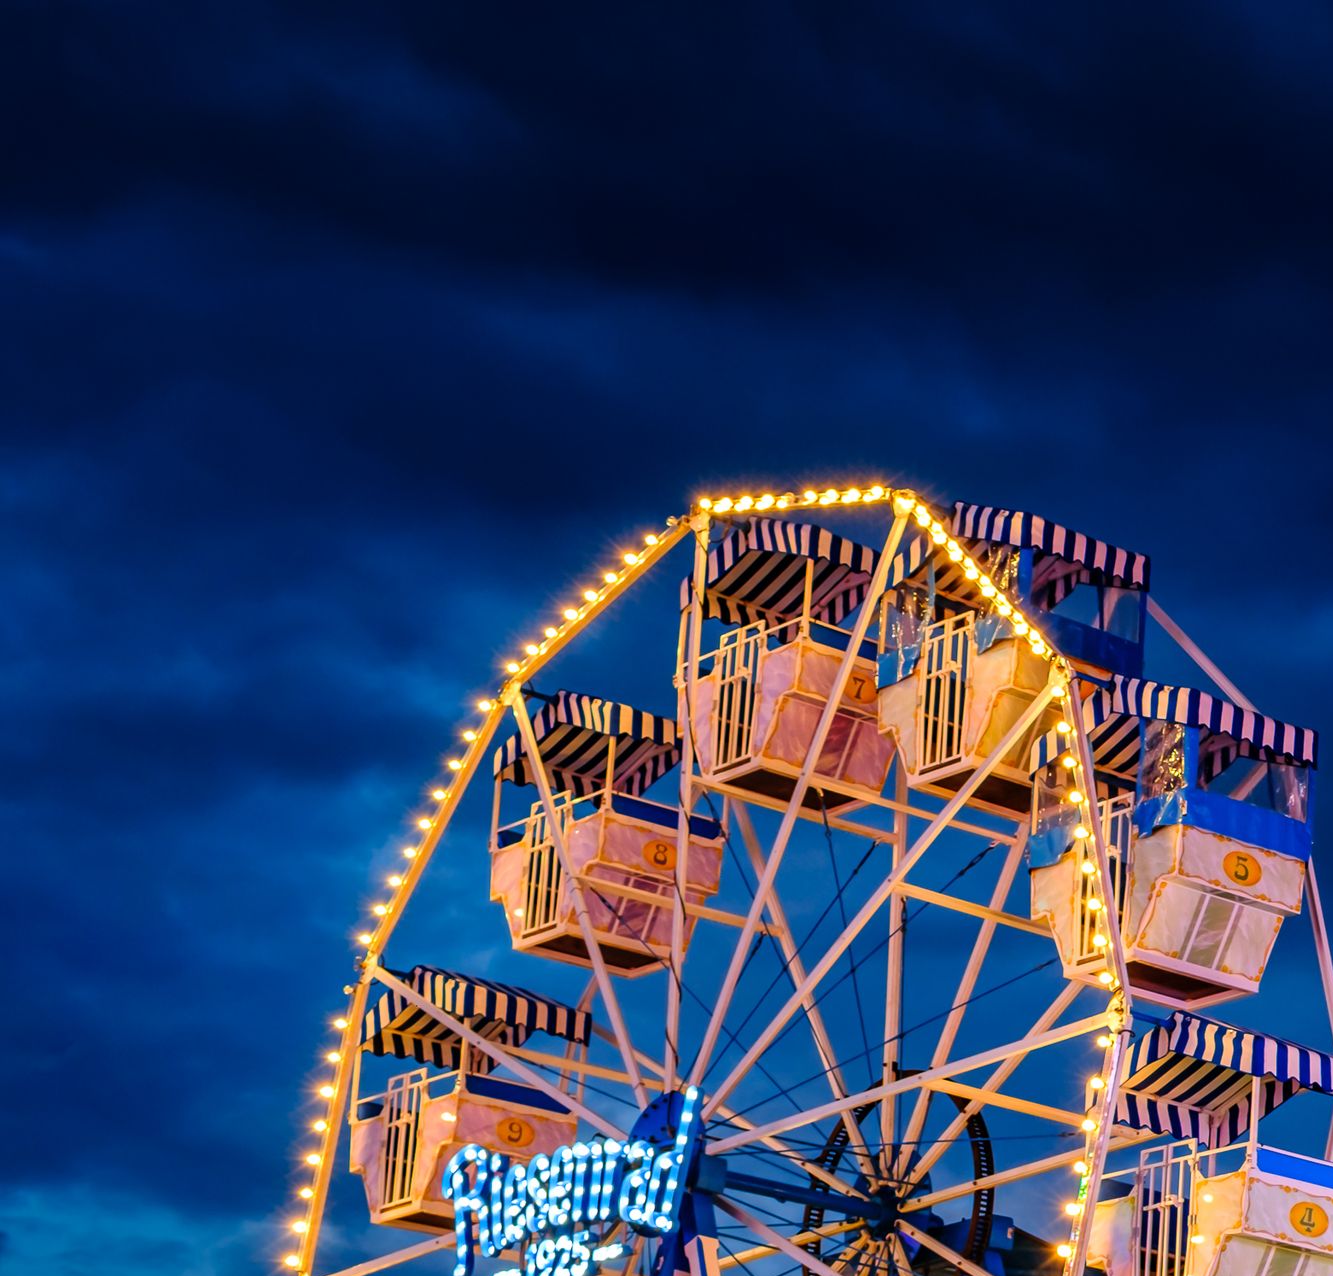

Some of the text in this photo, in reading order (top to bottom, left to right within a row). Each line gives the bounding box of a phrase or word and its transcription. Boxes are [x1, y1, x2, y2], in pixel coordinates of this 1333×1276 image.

[852, 676, 866, 700] 7
[653, 843, 668, 866] 8
[1234, 855, 1249, 881] 5
[507, 1121, 524, 1144] 9
[1299, 1207, 1316, 1233] 4
